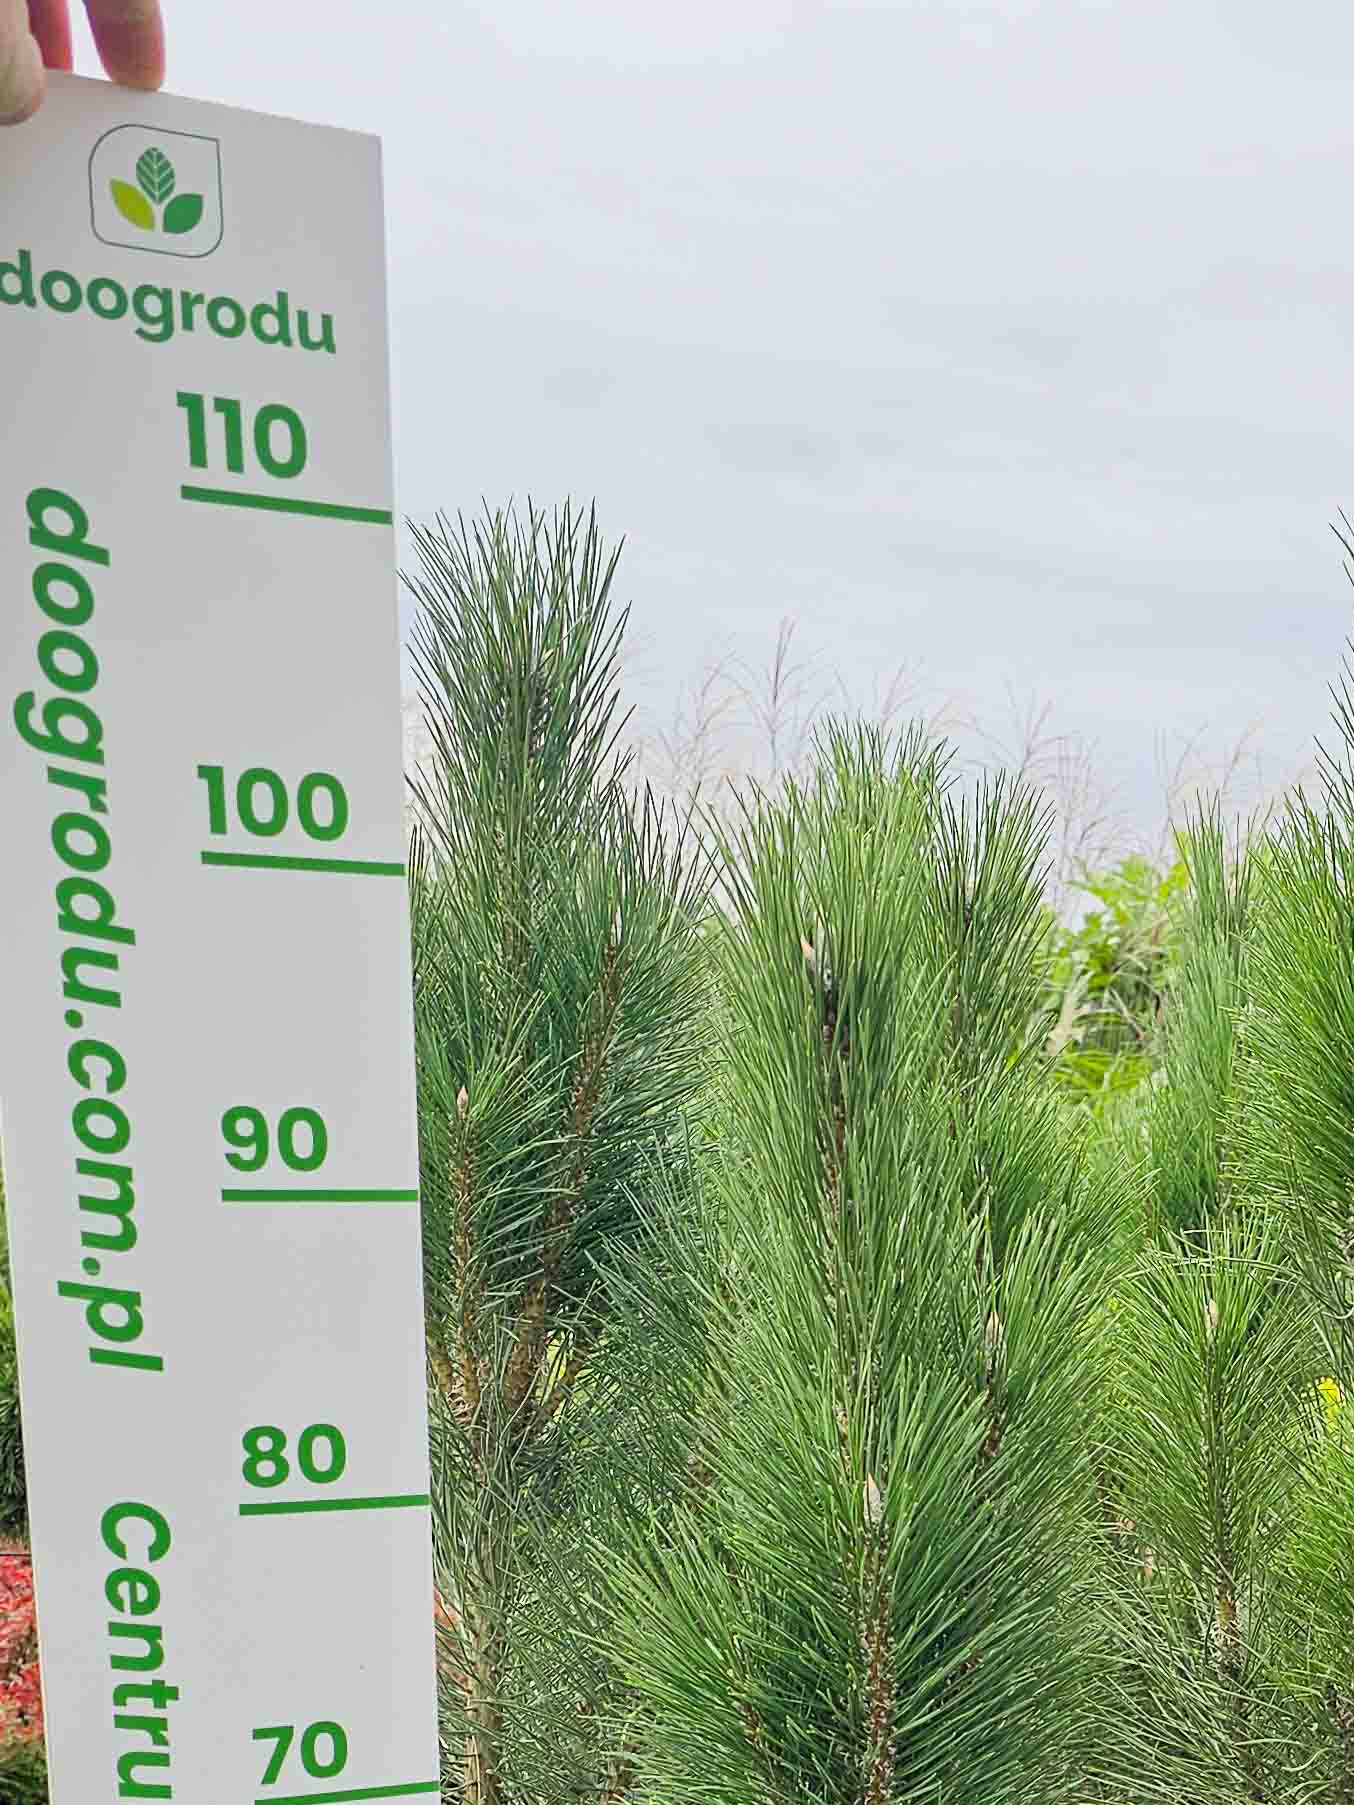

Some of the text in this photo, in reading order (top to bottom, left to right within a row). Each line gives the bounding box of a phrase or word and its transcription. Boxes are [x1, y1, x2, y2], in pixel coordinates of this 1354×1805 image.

[0, 248, 337, 354] doogrodu
[176, 391, 307, 479] 110
[198, 765, 349, 842] 100
[14, 486, 165, 1373] doogrodu.com.pl
[221, 1105, 329, 1173] 90
[240, 1422, 347, 1489] 80
[251, 1720, 349, 1786] 70
